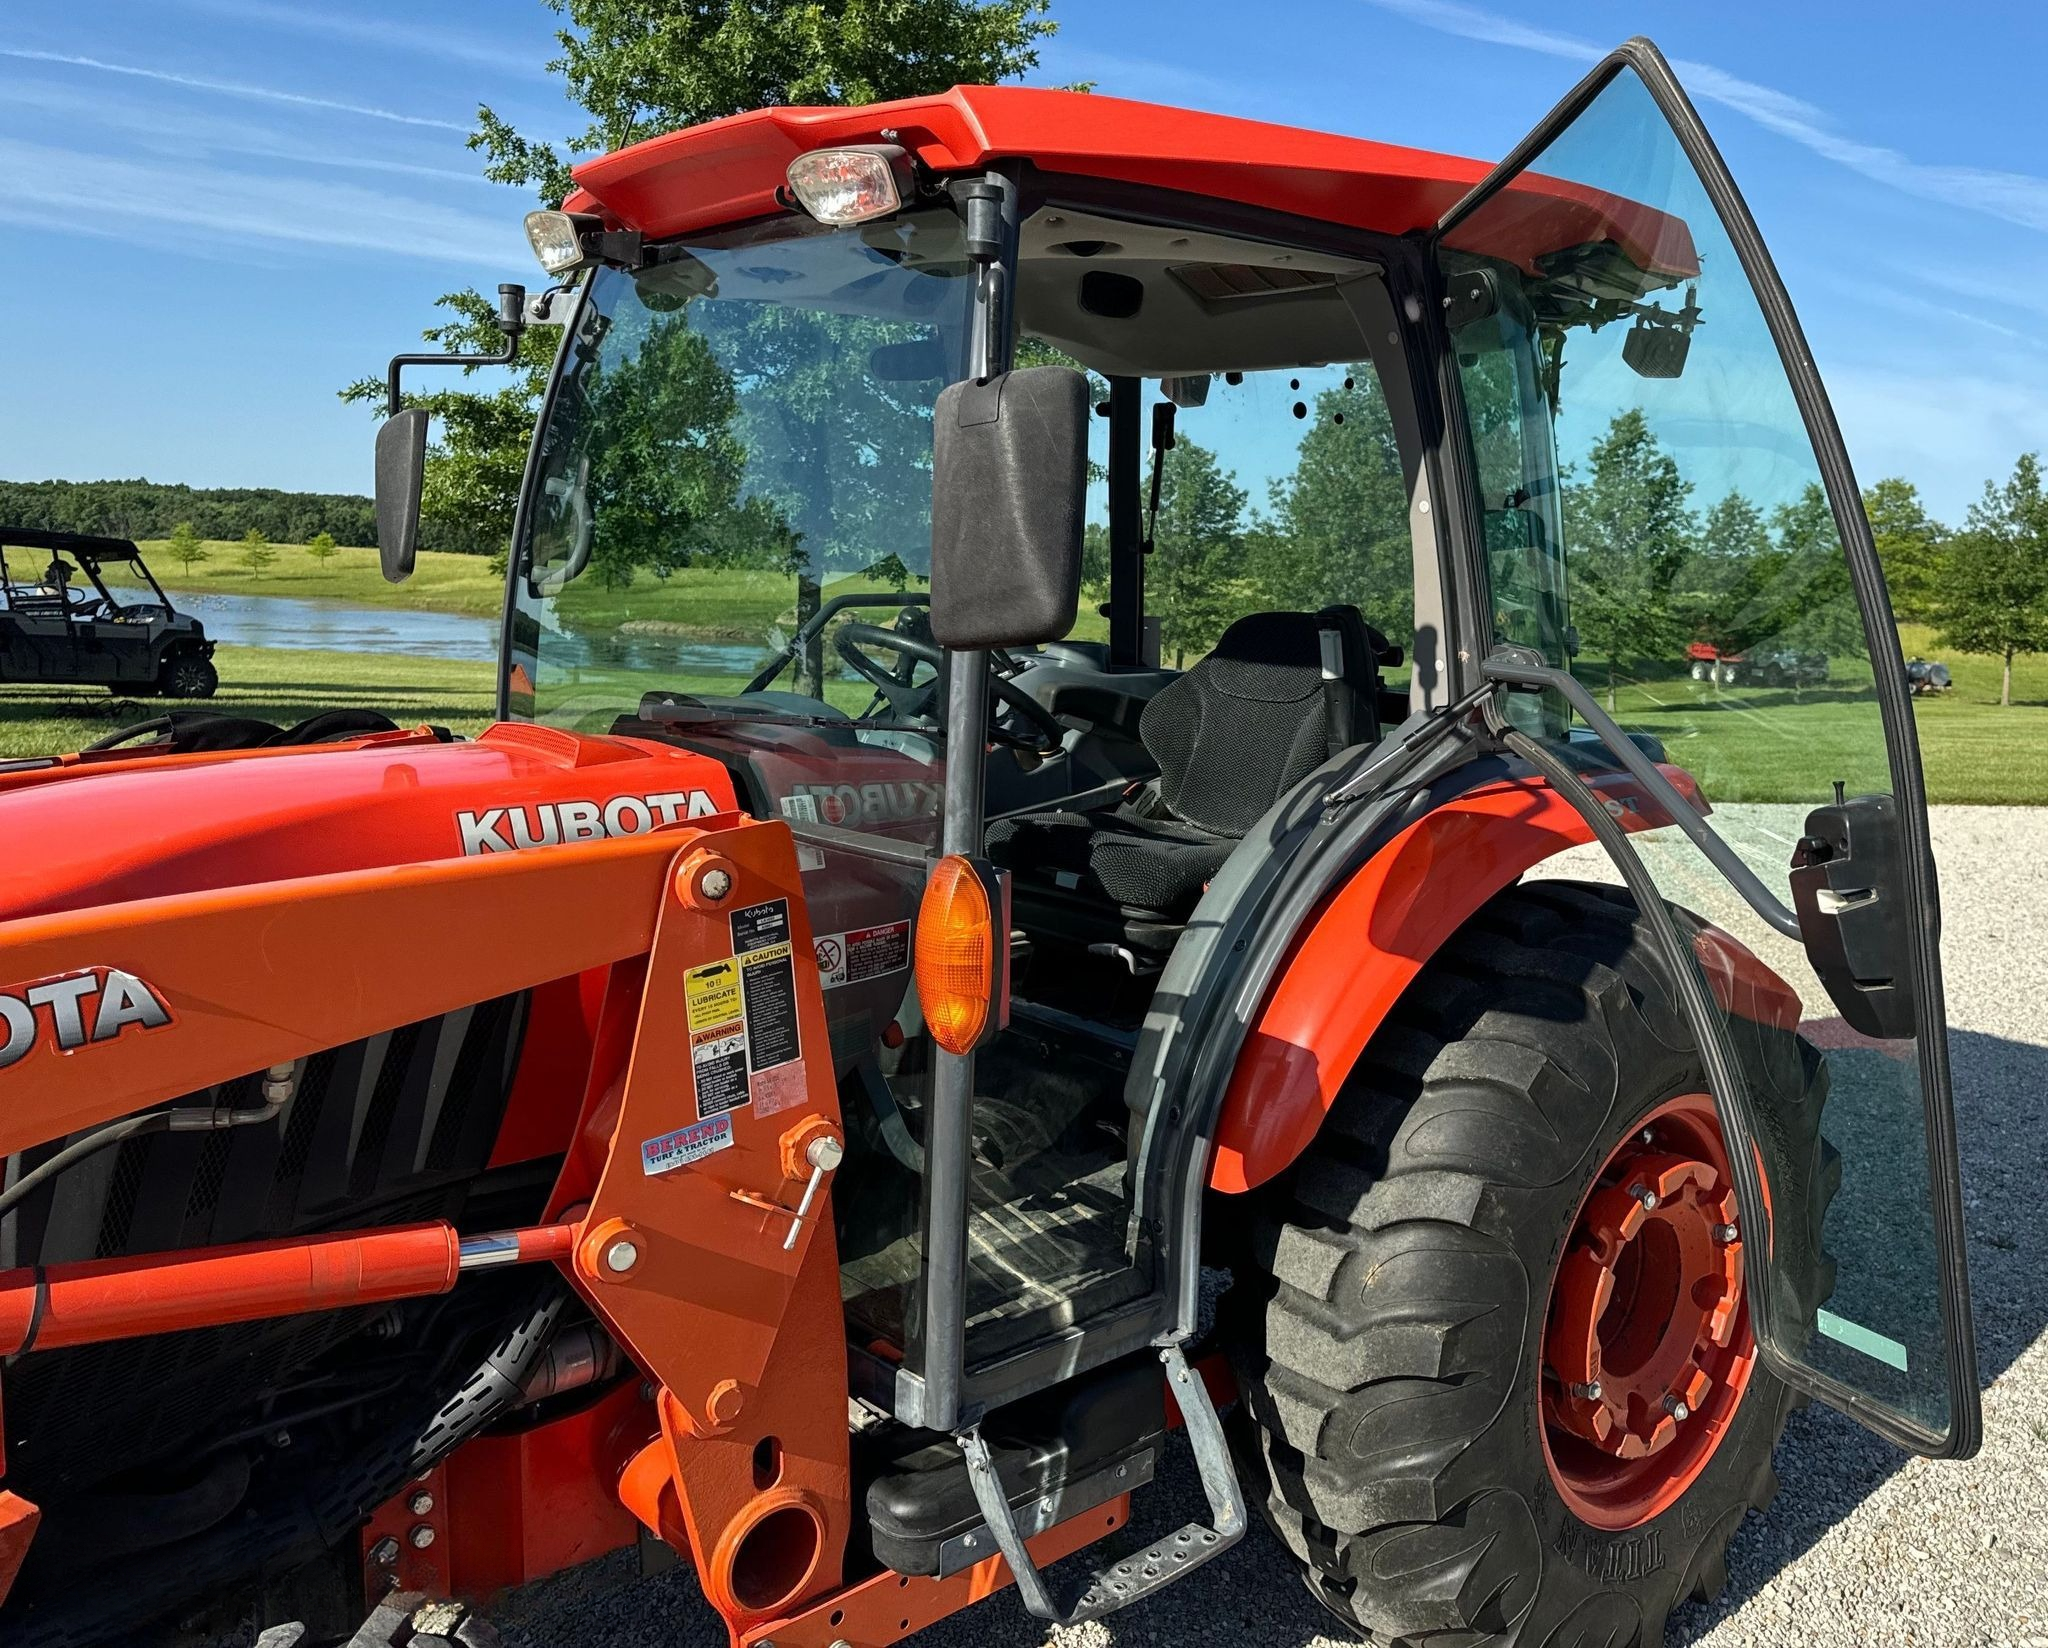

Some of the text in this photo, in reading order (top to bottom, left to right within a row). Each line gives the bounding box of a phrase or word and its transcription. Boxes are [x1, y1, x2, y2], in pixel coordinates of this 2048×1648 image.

[457, 789, 720, 857] KUBOTA
[745, 905, 774, 918] Kubota
[872, 926, 894, 936] DANGER
[752, 946, 788, 962] CAUTION
[705, 980, 715, 989] 10
[692, 988, 737, 1007] LUBRICATE
[702, 1023, 741, 1041] WARNING
[646, 1118, 730, 1158] BEREND
[650, 1150, 674, 1164] TURF
[676, 1147, 682, 1155] &
[684, 1132, 728, 1153] TRACTOR
